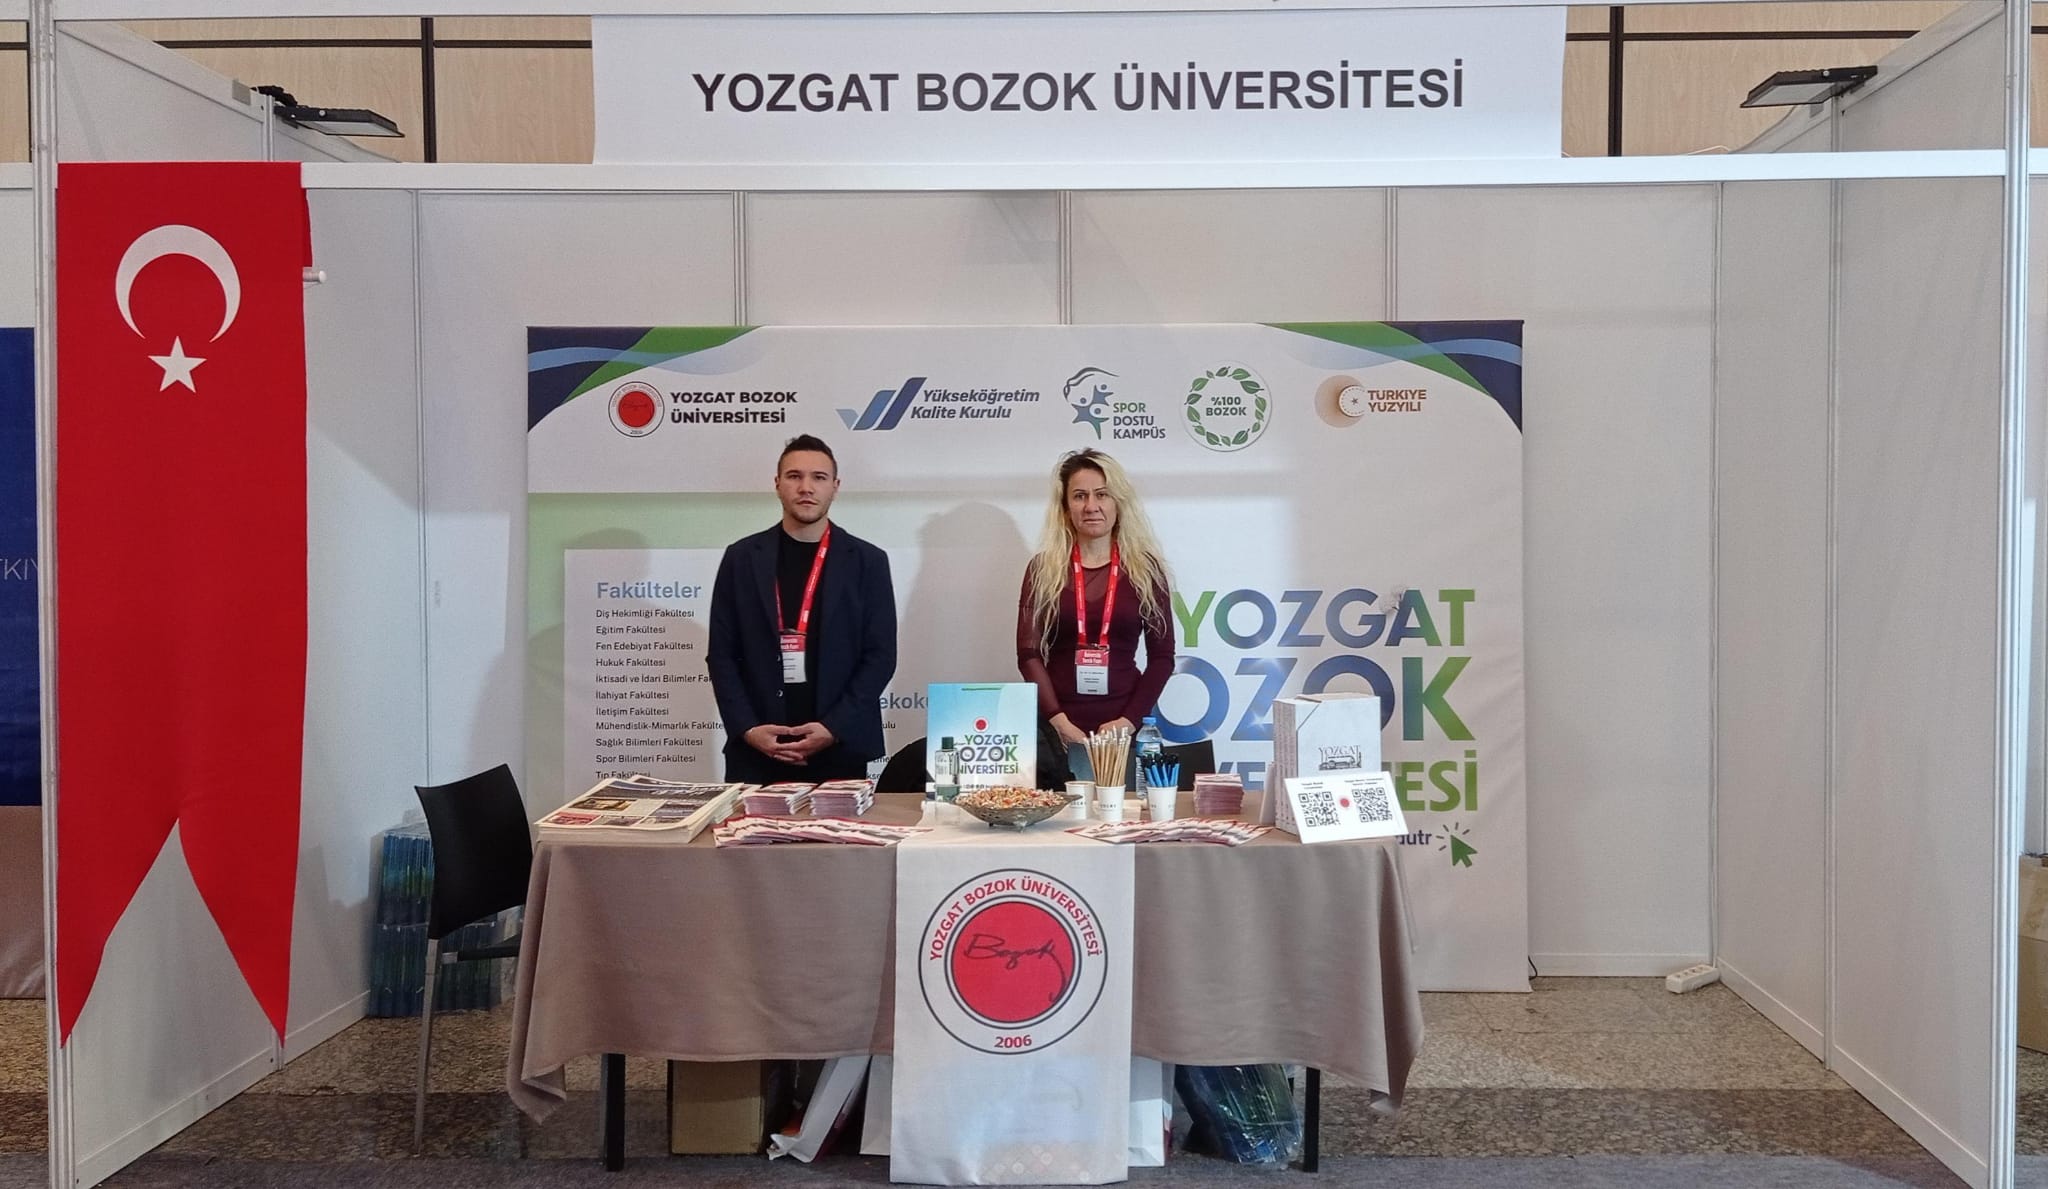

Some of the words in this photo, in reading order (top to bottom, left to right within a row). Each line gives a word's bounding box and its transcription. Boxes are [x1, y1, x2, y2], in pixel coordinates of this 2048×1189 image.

[692, 73, 899, 112] YOZGAT
[916, 71, 1097, 112] BOZOK
[1114, 59, 1464, 111] ÜNİVERSİTESİ
[670, 392, 735, 404] YOZGAT
[740, 392, 797, 403] BOZOK
[923, 389, 1040, 404] Yükseköğretim
[1211, 396, 1241, 406] %100
[911, 406, 956, 419] Kalite
[960, 406, 1012, 419] Kurulu
[1113, 403, 1146, 413] SPOR
[1206, 407, 1247, 416] BOZOK
[671, 408, 785, 424] ÜNİVERSİTESİ
[1113, 416, 1154, 426] DOSTU
[1113, 426, 1166, 439] KAMPÜS
[596, 581, 702, 599] Fakülteler
[612, 609, 653, 618] Hekimliği
[655, 609, 694, 617] Fakültesi
[1173, 588, 1476, 649] YOZGAT
[596, 626, 624, 635] Eğitim
[626, 625, 666, 633] Fakültesi
[596, 642, 612, 650] Fen
[614, 642, 651, 651] Edebiyat
[654, 642, 693, 650] Fakültesi
[596, 658, 624, 666] Hukuk
[626, 658, 666, 666] Fakültesi
[663, 674, 696, 682] Bilimler
[630, 691, 669, 699] Fakültesi
[1152, 655, 1476, 743] OZOK
[630, 707, 669, 715] Fakültesi
[692, 721, 724, 729] Fakülte
[596, 738, 624, 748] Sağlık
[626, 737, 661, 746] Bilimleri
[664, 737, 703, 746] Fakültesi
[964, 734, 1019, 745] YOZGAT
[960, 746, 1018, 762] OZOK
[1319, 745, 1361, 756] YOZGAT
[596, 755, 616, 764] Spor
[619, 754, 654, 763] Bilimleri
[657, 754, 696, 763] Fakültesi
[959, 764, 1019, 774] NİVERSİTESİ
[930, 901, 964, 960] YOZGAT
[964, 878, 1017, 906] BOZOK
[1021, 876, 1102, 957] ÜNİVERSİTESİ
[994, 1034, 1032, 1049] 2006
